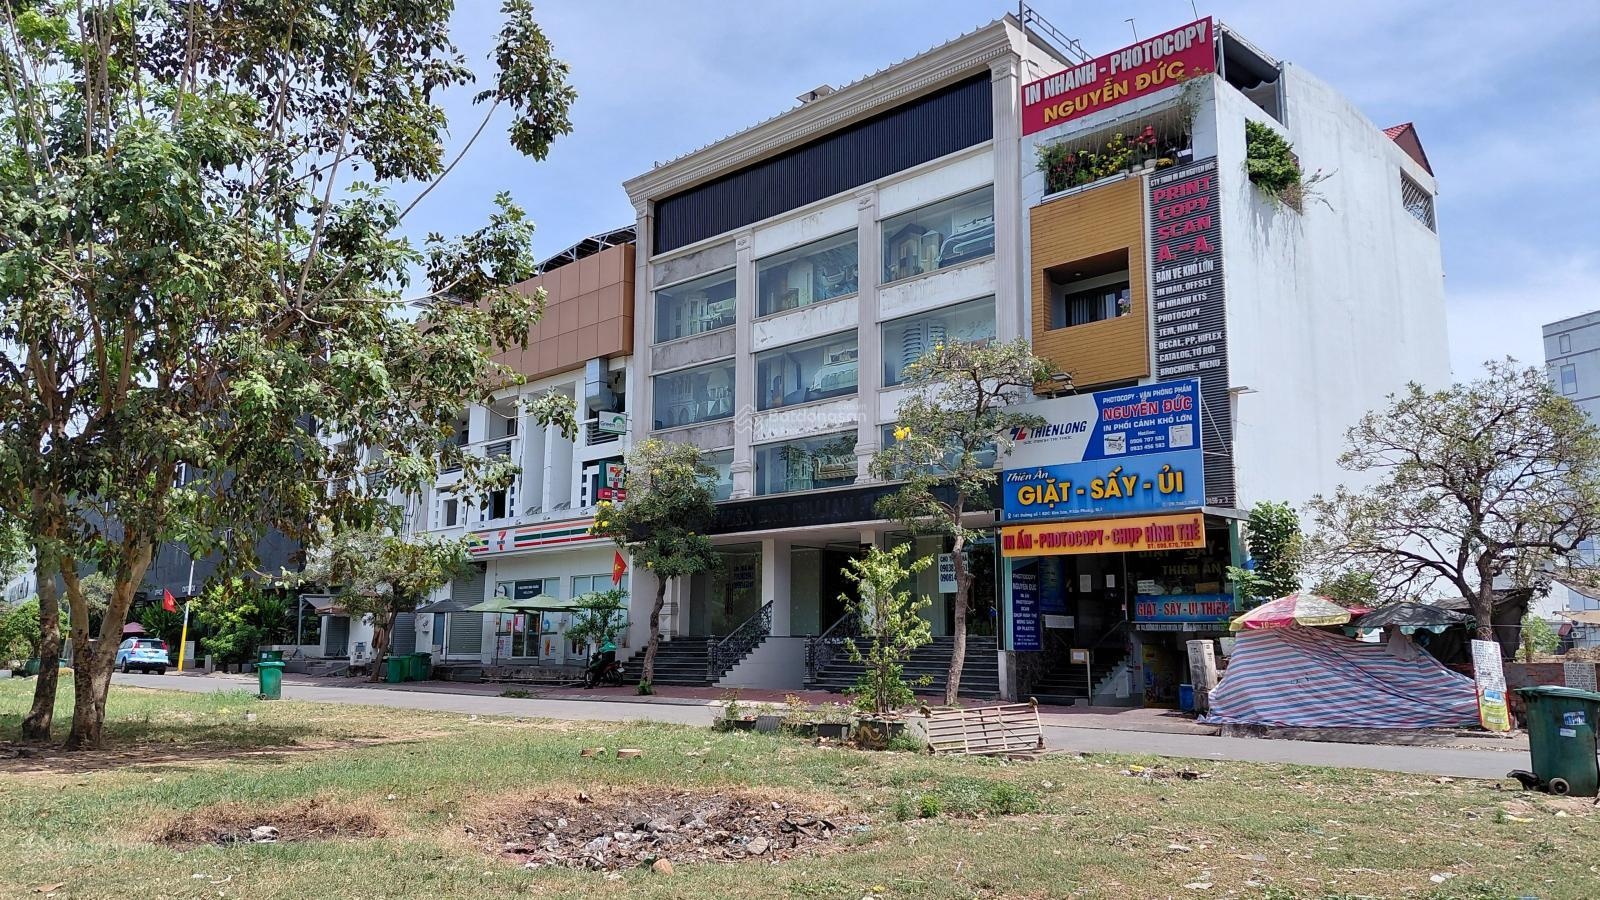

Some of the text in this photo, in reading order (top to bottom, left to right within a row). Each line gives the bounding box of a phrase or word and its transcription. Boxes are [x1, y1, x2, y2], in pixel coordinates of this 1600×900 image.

[1025, 85, 1041, 106] IN
[1044, 62, 1097, 100] NHANH
[1110, 21, 1207, 75] PHOTOCOPY
[1044, 60, 1185, 124] NGUYỄN ĐỨC
[1153, 176, 1212, 204] PRINT
[1158, 196, 1209, 220] COPY
[1157, 216, 1210, 240] SCAN
[1157, 288, 1165, 296] IN
[1185, 278, 1212, 290] OFFSET
[1167, 295, 1191, 308] NHANH
[1192, 293, 1207, 302] KTS
[1158, 308, 1201, 323] PHOTOCOPY
[1198, 331, 1222, 343] HIFLEX
[1199, 359, 1221, 370] MENU
[1103, 393, 1135, 404] PHOTOCOPY
[1153, 387, 1173, 397] PHÒNG
[1103, 394, 1192, 421] NGUYỄN ĐỨC
[1114, 420, 1131, 431] PHỐI
[1134, 418, 1155, 428] CẢNH
[1158, 413, 1174, 424] KHỔ
[1176, 413, 1192, 423] LỚN
[1007, 467, 1048, 482] Thiên Ân
[1018, 478, 1071, 508] GIẶT
[1090, 466, 1137, 499] SẤY
[1158, 464, 1183, 494] ỦI
[1003, 535, 1015, 549] IN
[1017, 529, 1032, 549] ẤN
[1039, 530, 1104, 548] PHOTOCOPY
[1111, 527, 1142, 547] CHỤP
[1145, 523, 1174, 542] HÌNH
[1176, 518, 1201, 541] THẺ
